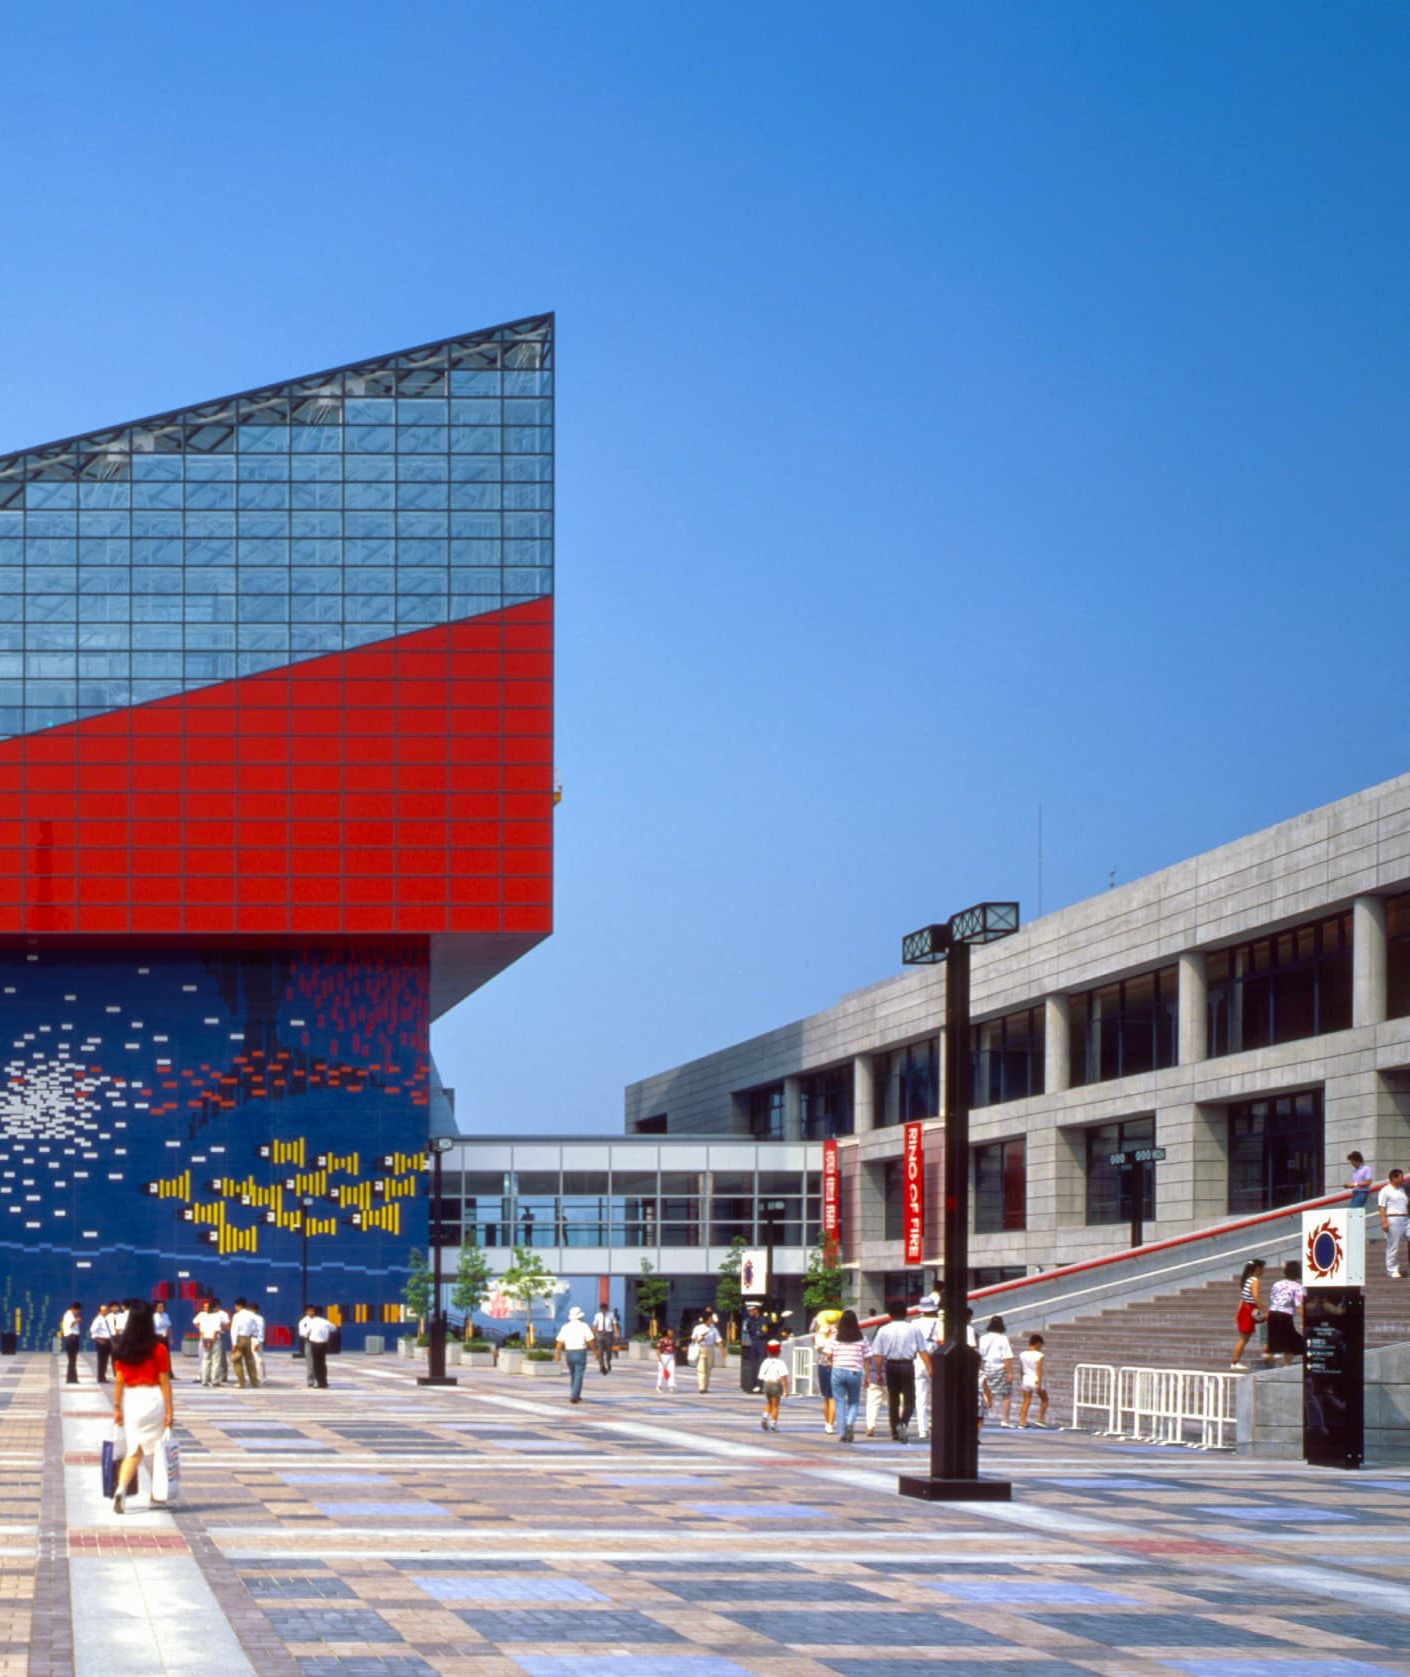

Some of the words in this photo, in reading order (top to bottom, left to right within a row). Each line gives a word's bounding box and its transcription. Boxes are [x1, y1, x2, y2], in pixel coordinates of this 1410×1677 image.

[908, 1127, 918, 1180] RING
[909, 1183, 919, 1213] OF
[908, 1217, 920, 1257] FIRE
